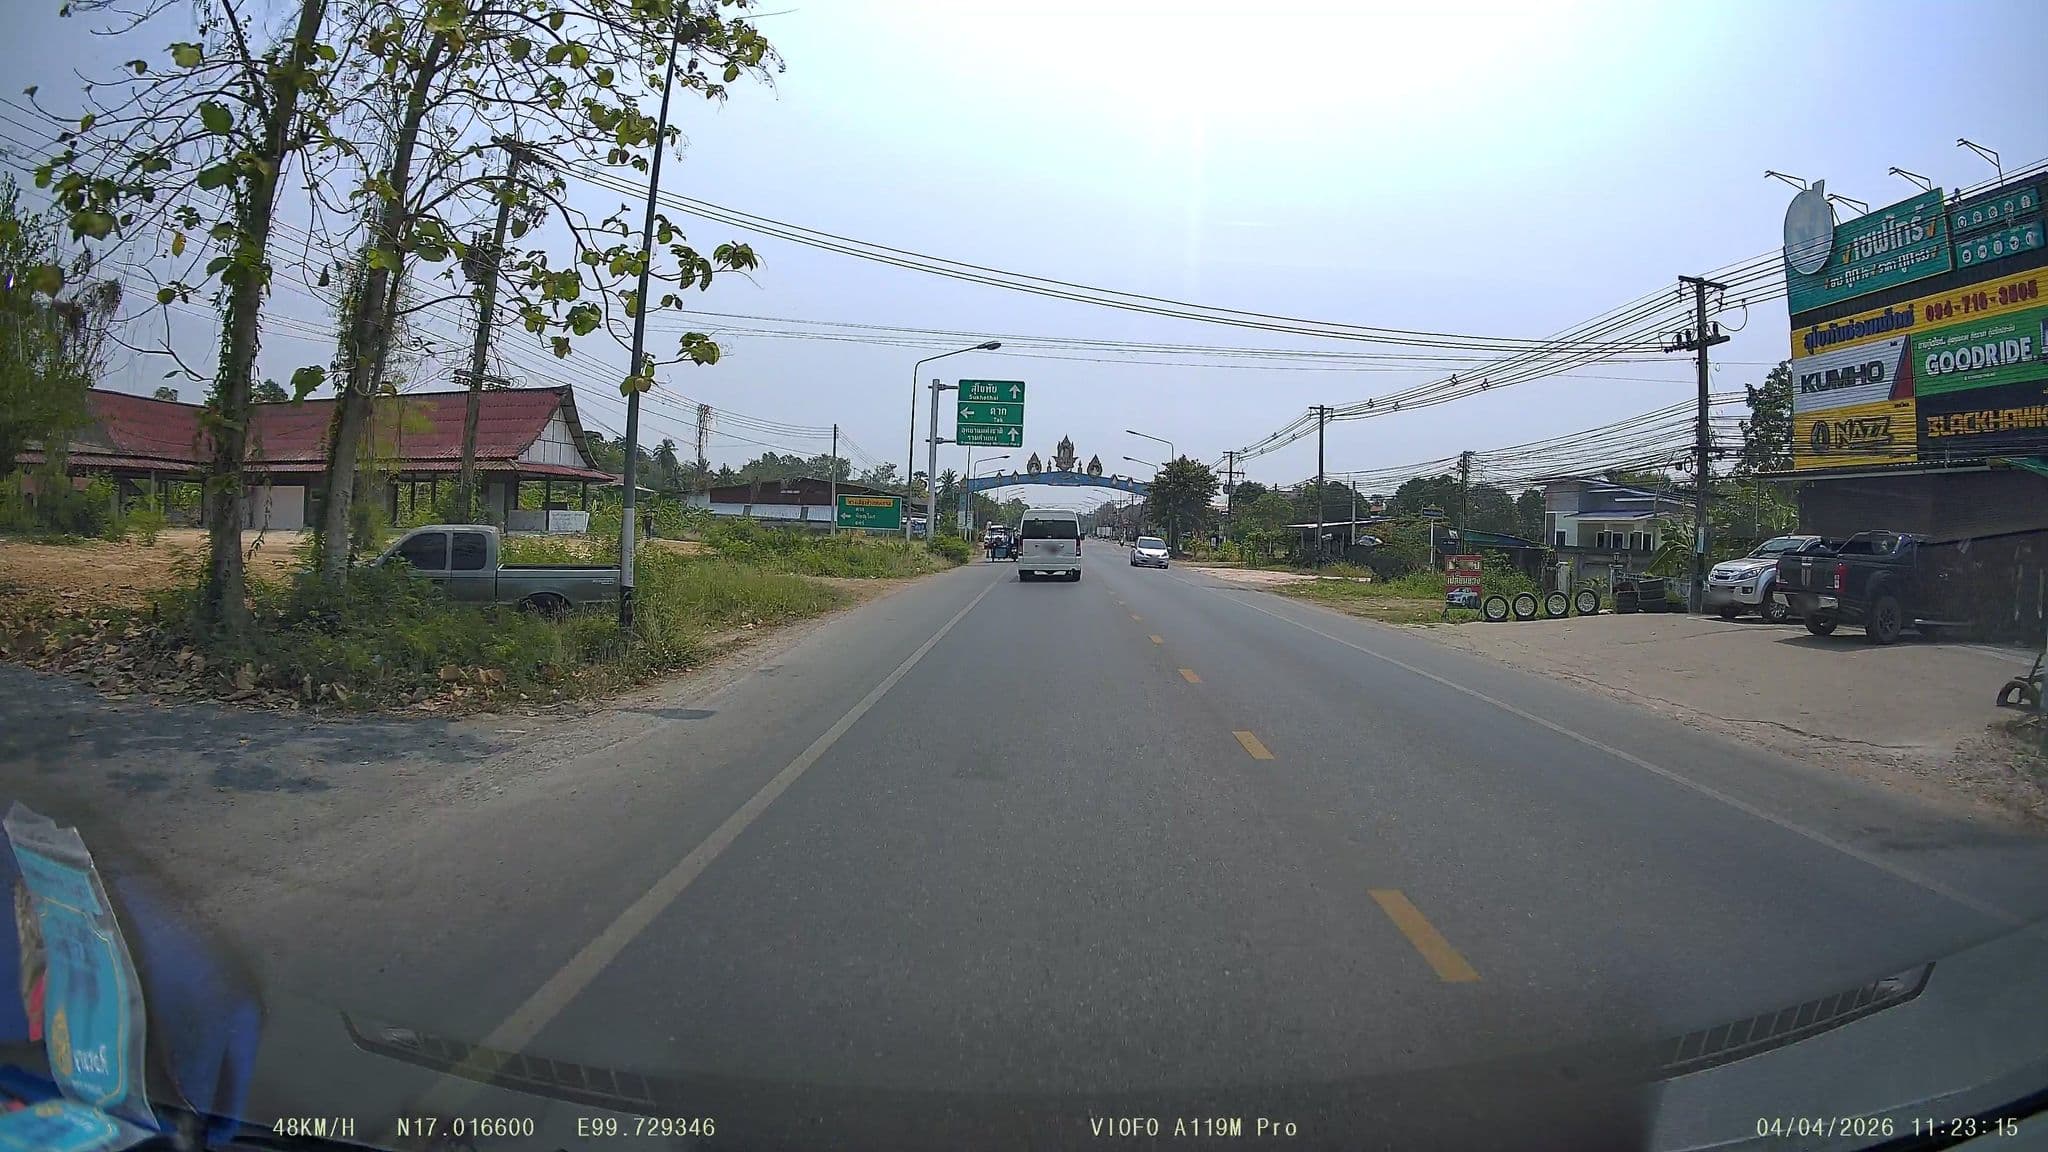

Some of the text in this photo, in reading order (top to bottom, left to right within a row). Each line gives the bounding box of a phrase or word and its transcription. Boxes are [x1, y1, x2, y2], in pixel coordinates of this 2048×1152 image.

[1925, 336, 2033, 376] GOODRIDE
[971, 382, 998, 395] สุโขทัย
[1800, 359, 1885, 394] KUMHO
[990, 407, 1007, 416] ตาก
